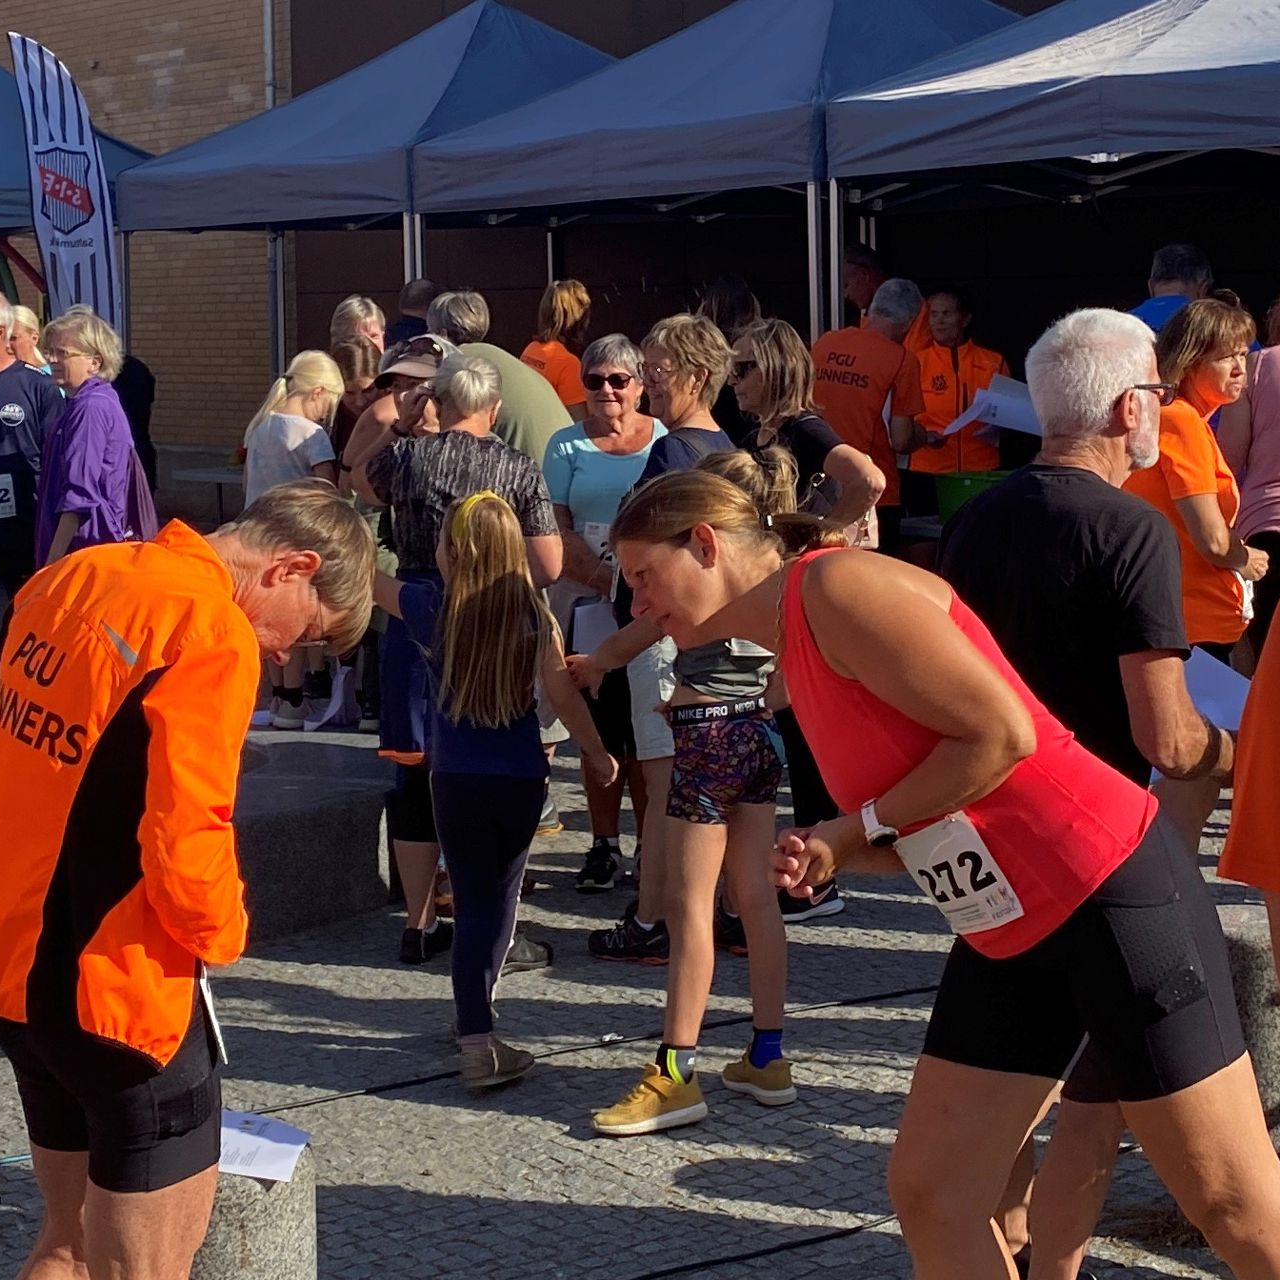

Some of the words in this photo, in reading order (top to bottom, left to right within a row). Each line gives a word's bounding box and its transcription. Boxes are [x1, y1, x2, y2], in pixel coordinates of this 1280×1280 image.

[826, 351, 857, 368] PGU
[8, 631, 67, 688] PGU
[677, 707, 704, 720] NIKE
[705, 705, 729, 718] PRO
[917, 850, 998, 903] 272
